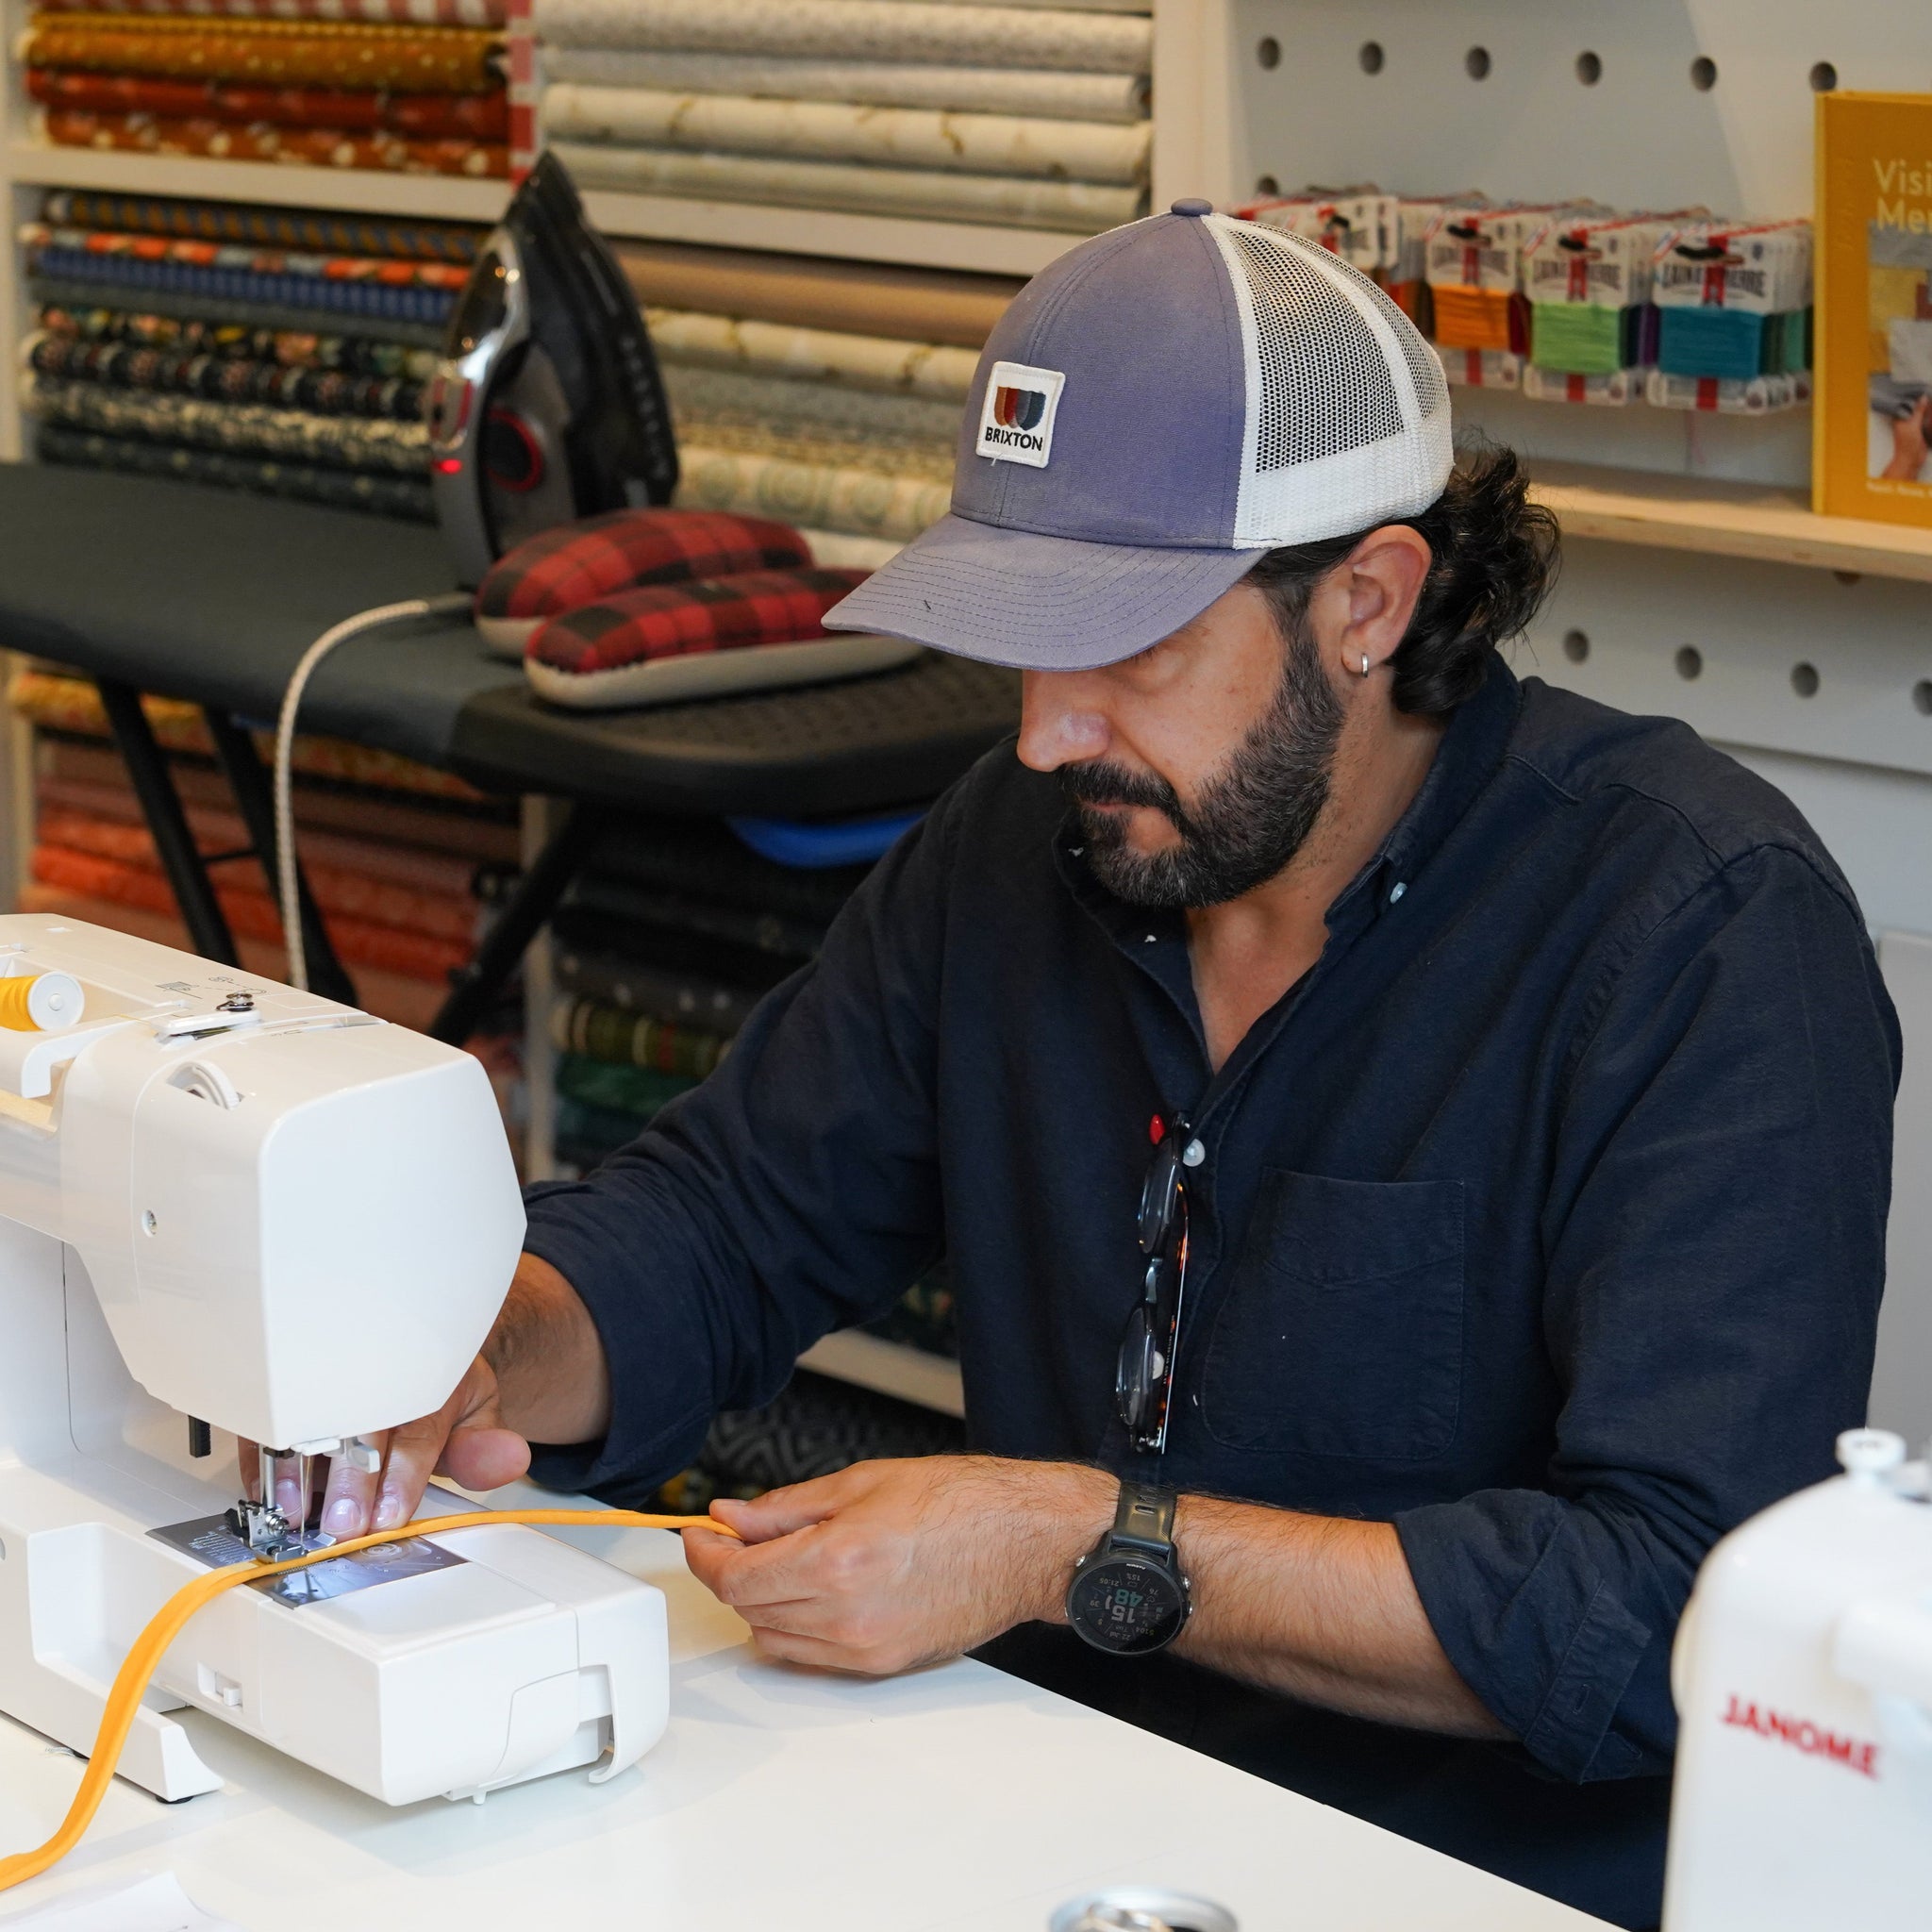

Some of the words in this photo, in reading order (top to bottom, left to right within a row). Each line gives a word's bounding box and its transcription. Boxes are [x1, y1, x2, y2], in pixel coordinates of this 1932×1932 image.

[985, 426, 1043, 451] BRIXTON
[1114, 1589, 1143, 1607] 48
[1111, 1605, 1136, 1624] 15
[1723, 1694, 1881, 1779] JANOME
